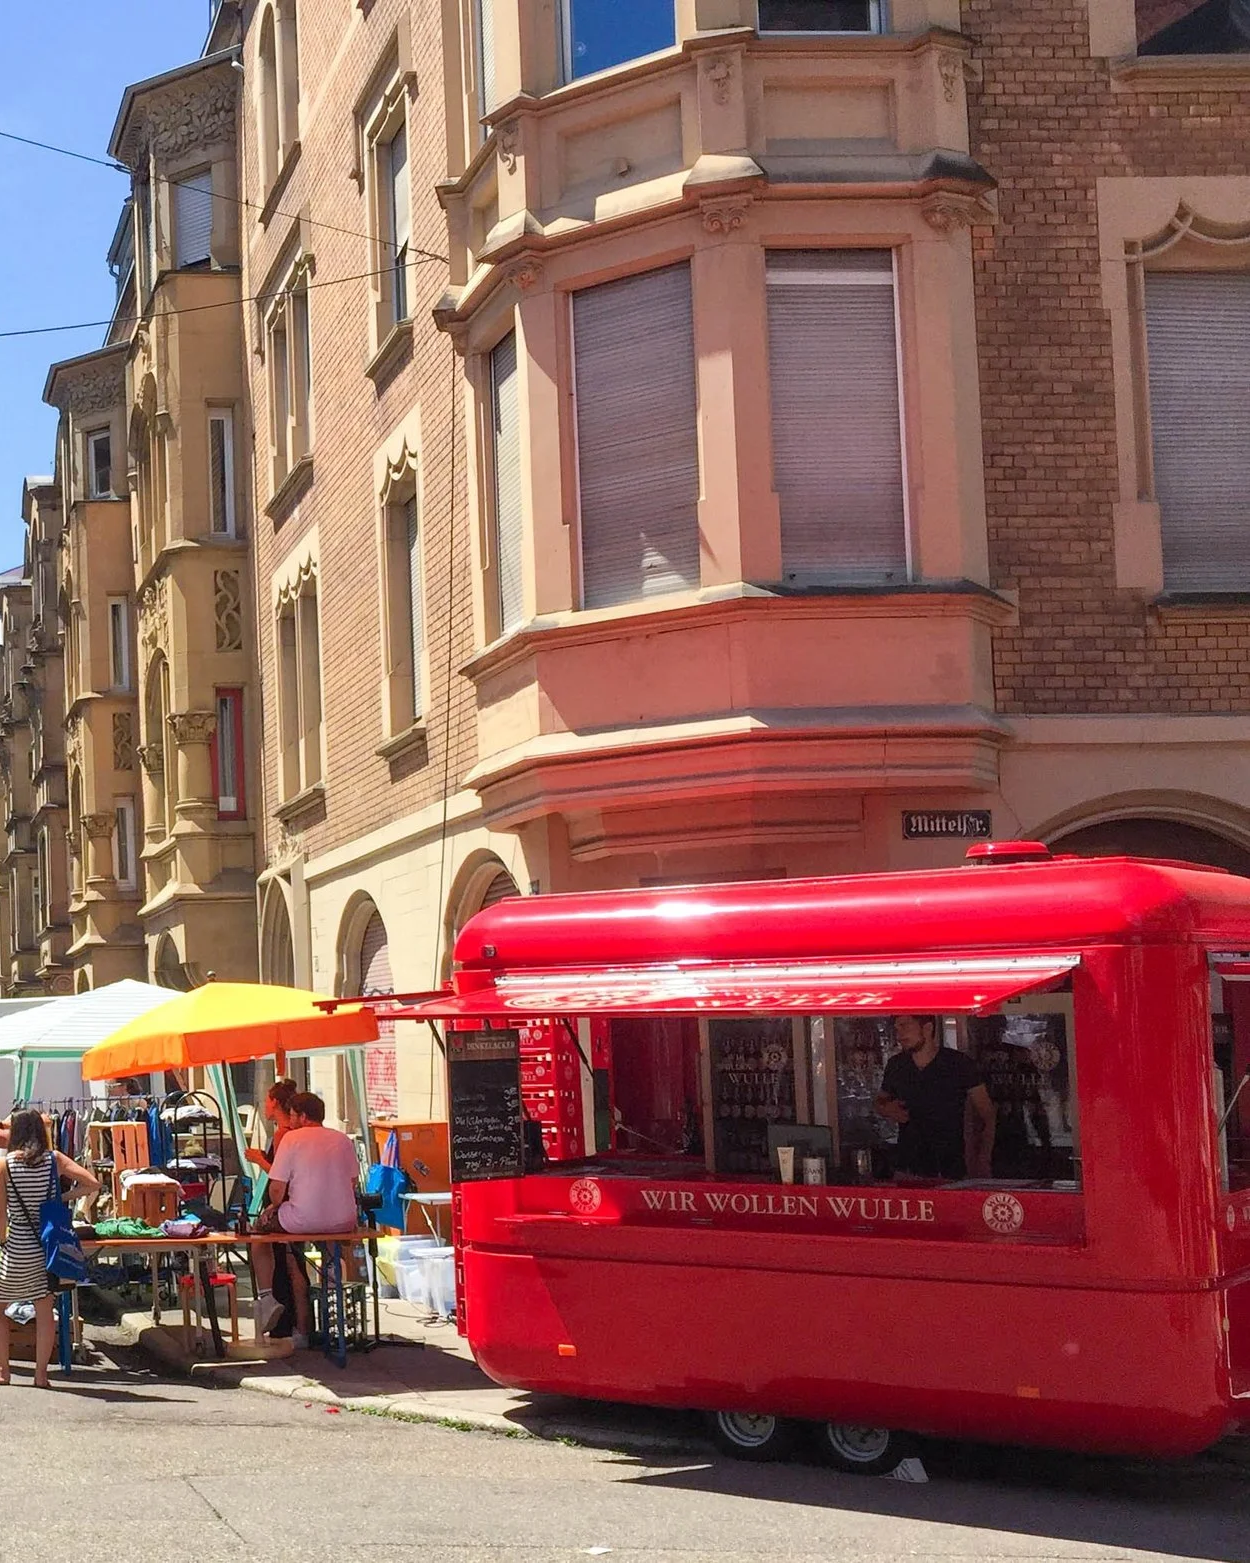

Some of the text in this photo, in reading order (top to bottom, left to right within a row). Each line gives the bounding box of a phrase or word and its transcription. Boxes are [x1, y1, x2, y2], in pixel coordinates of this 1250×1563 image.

[640, 1189, 935, 1222] WIR WOLLEN WULLE
